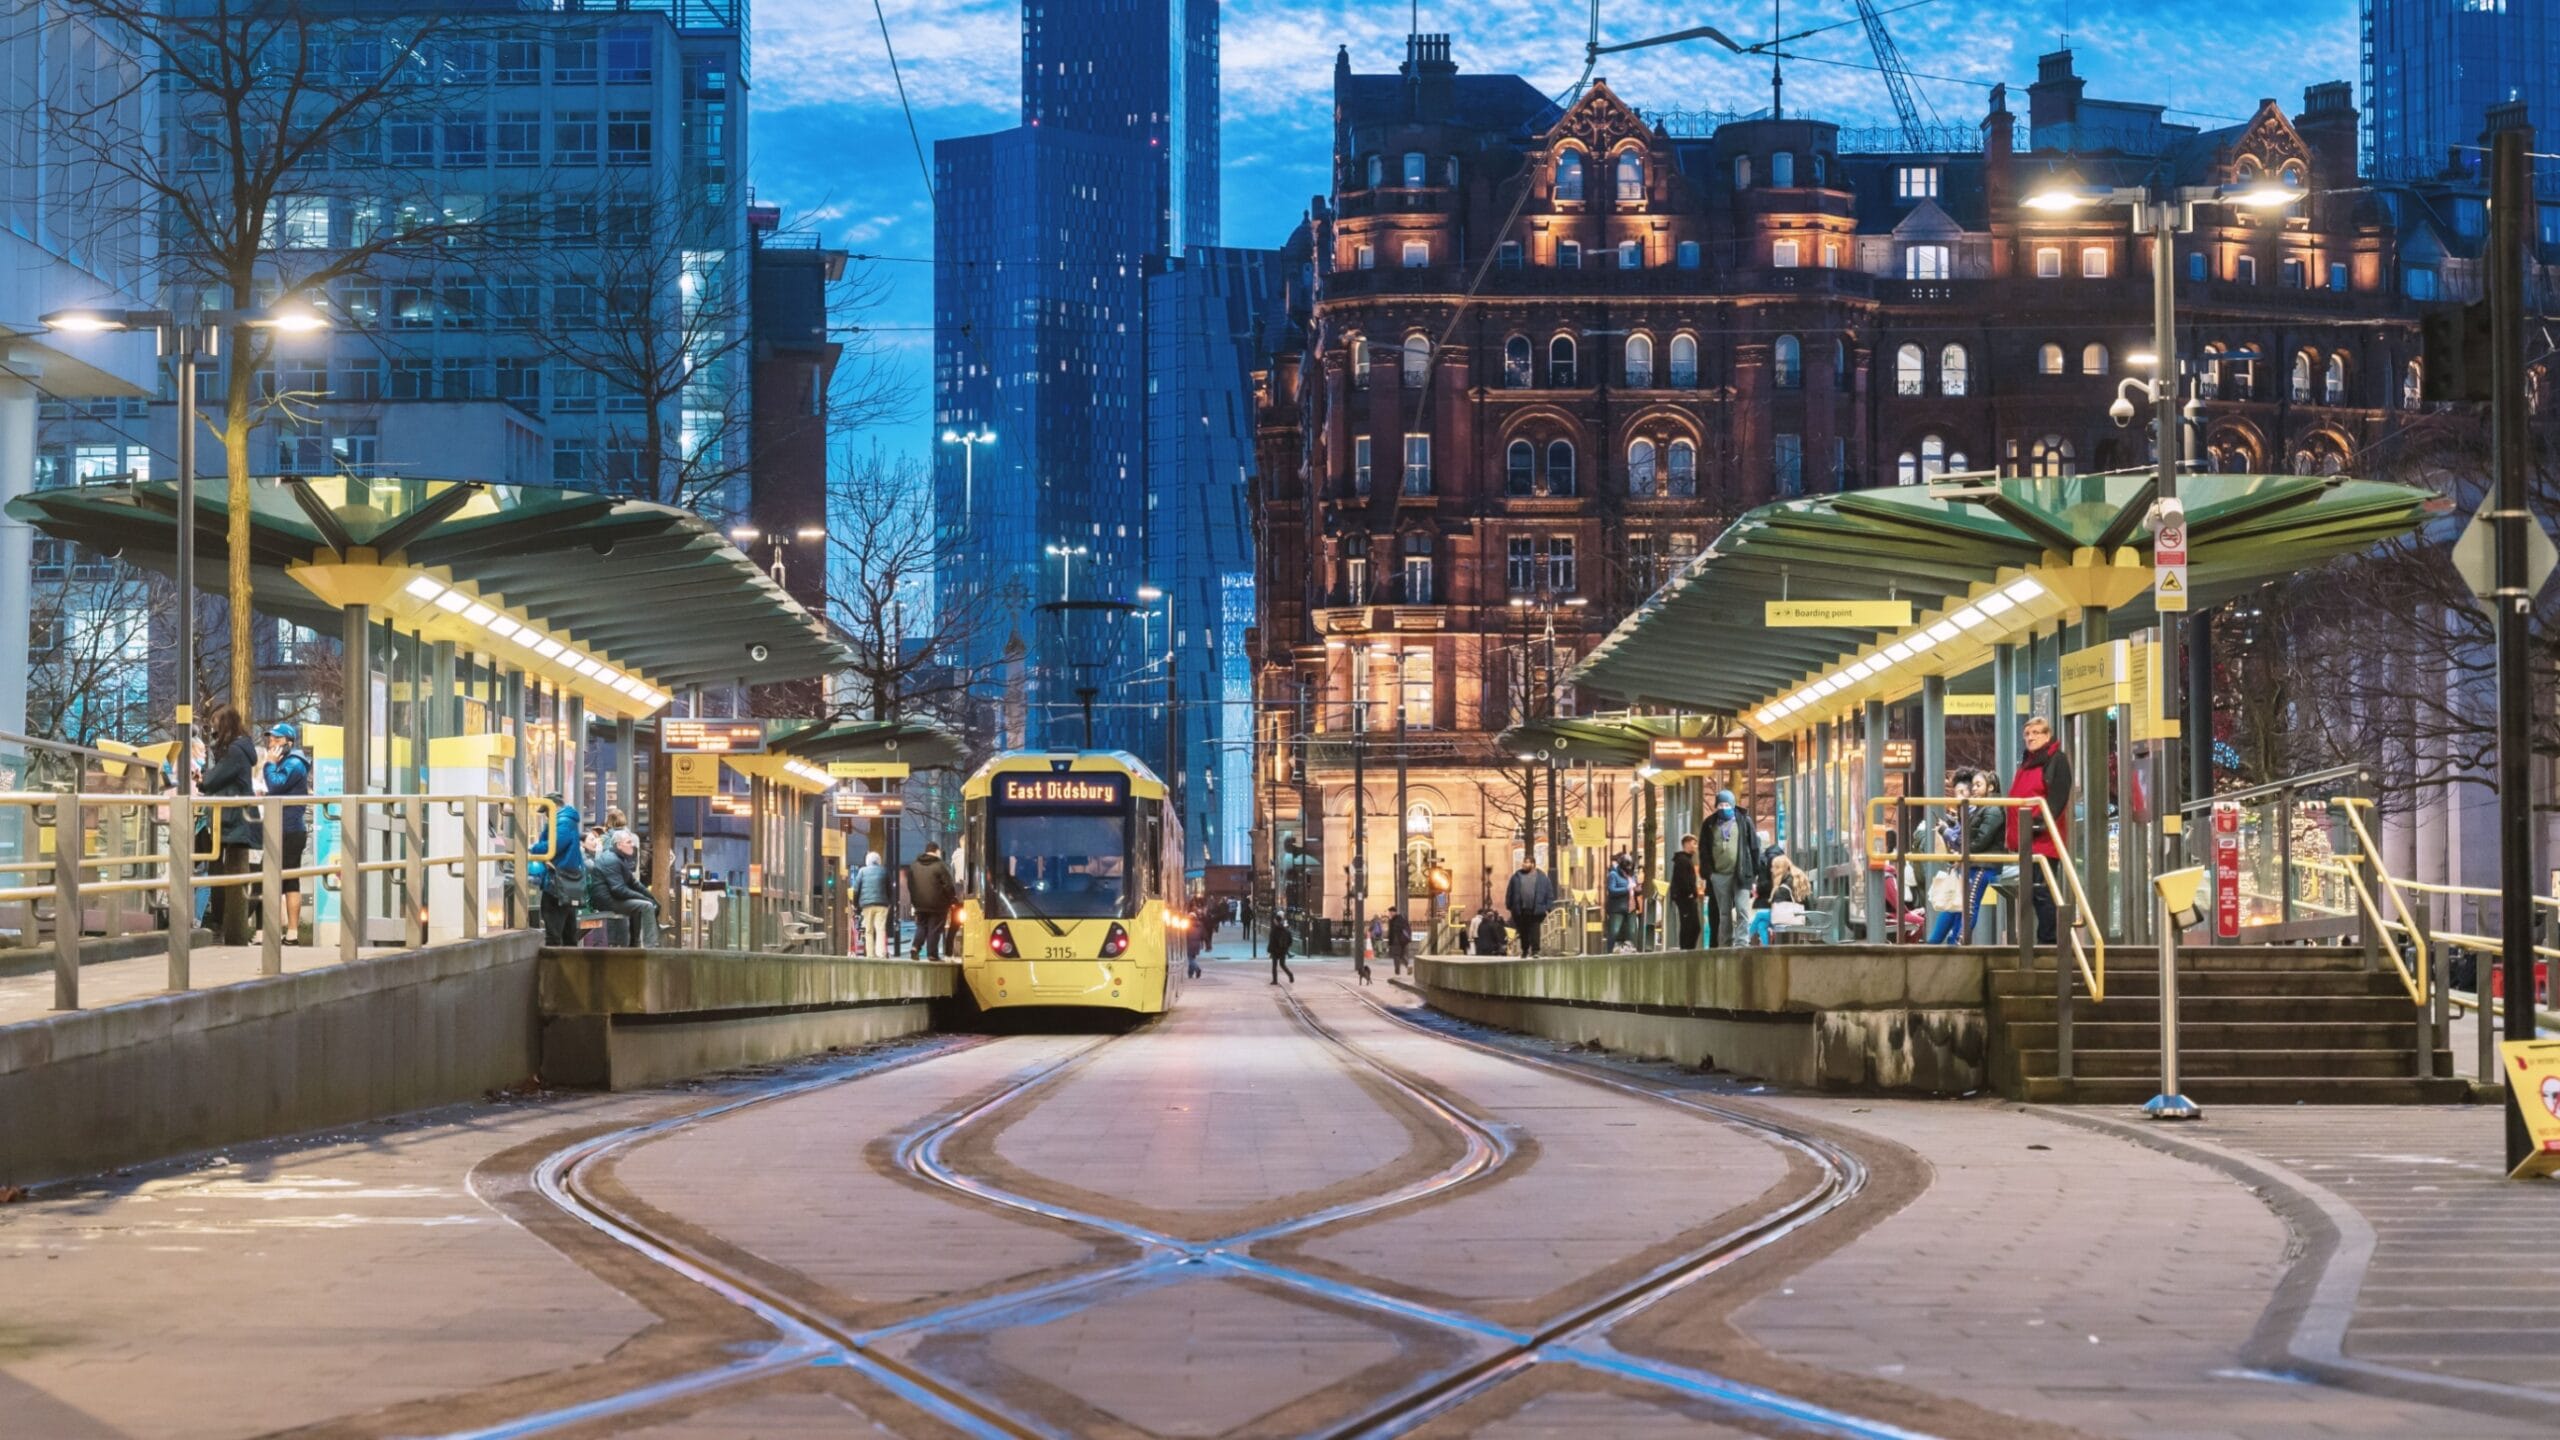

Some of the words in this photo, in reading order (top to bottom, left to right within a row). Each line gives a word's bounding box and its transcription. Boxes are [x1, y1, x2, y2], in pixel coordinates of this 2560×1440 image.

[1795, 608, 1830, 619] Boarding
[1831, 609, 1853, 618] point
[1008, 781, 1042, 799] East
[1047, 781, 1113, 802] Didsbury
